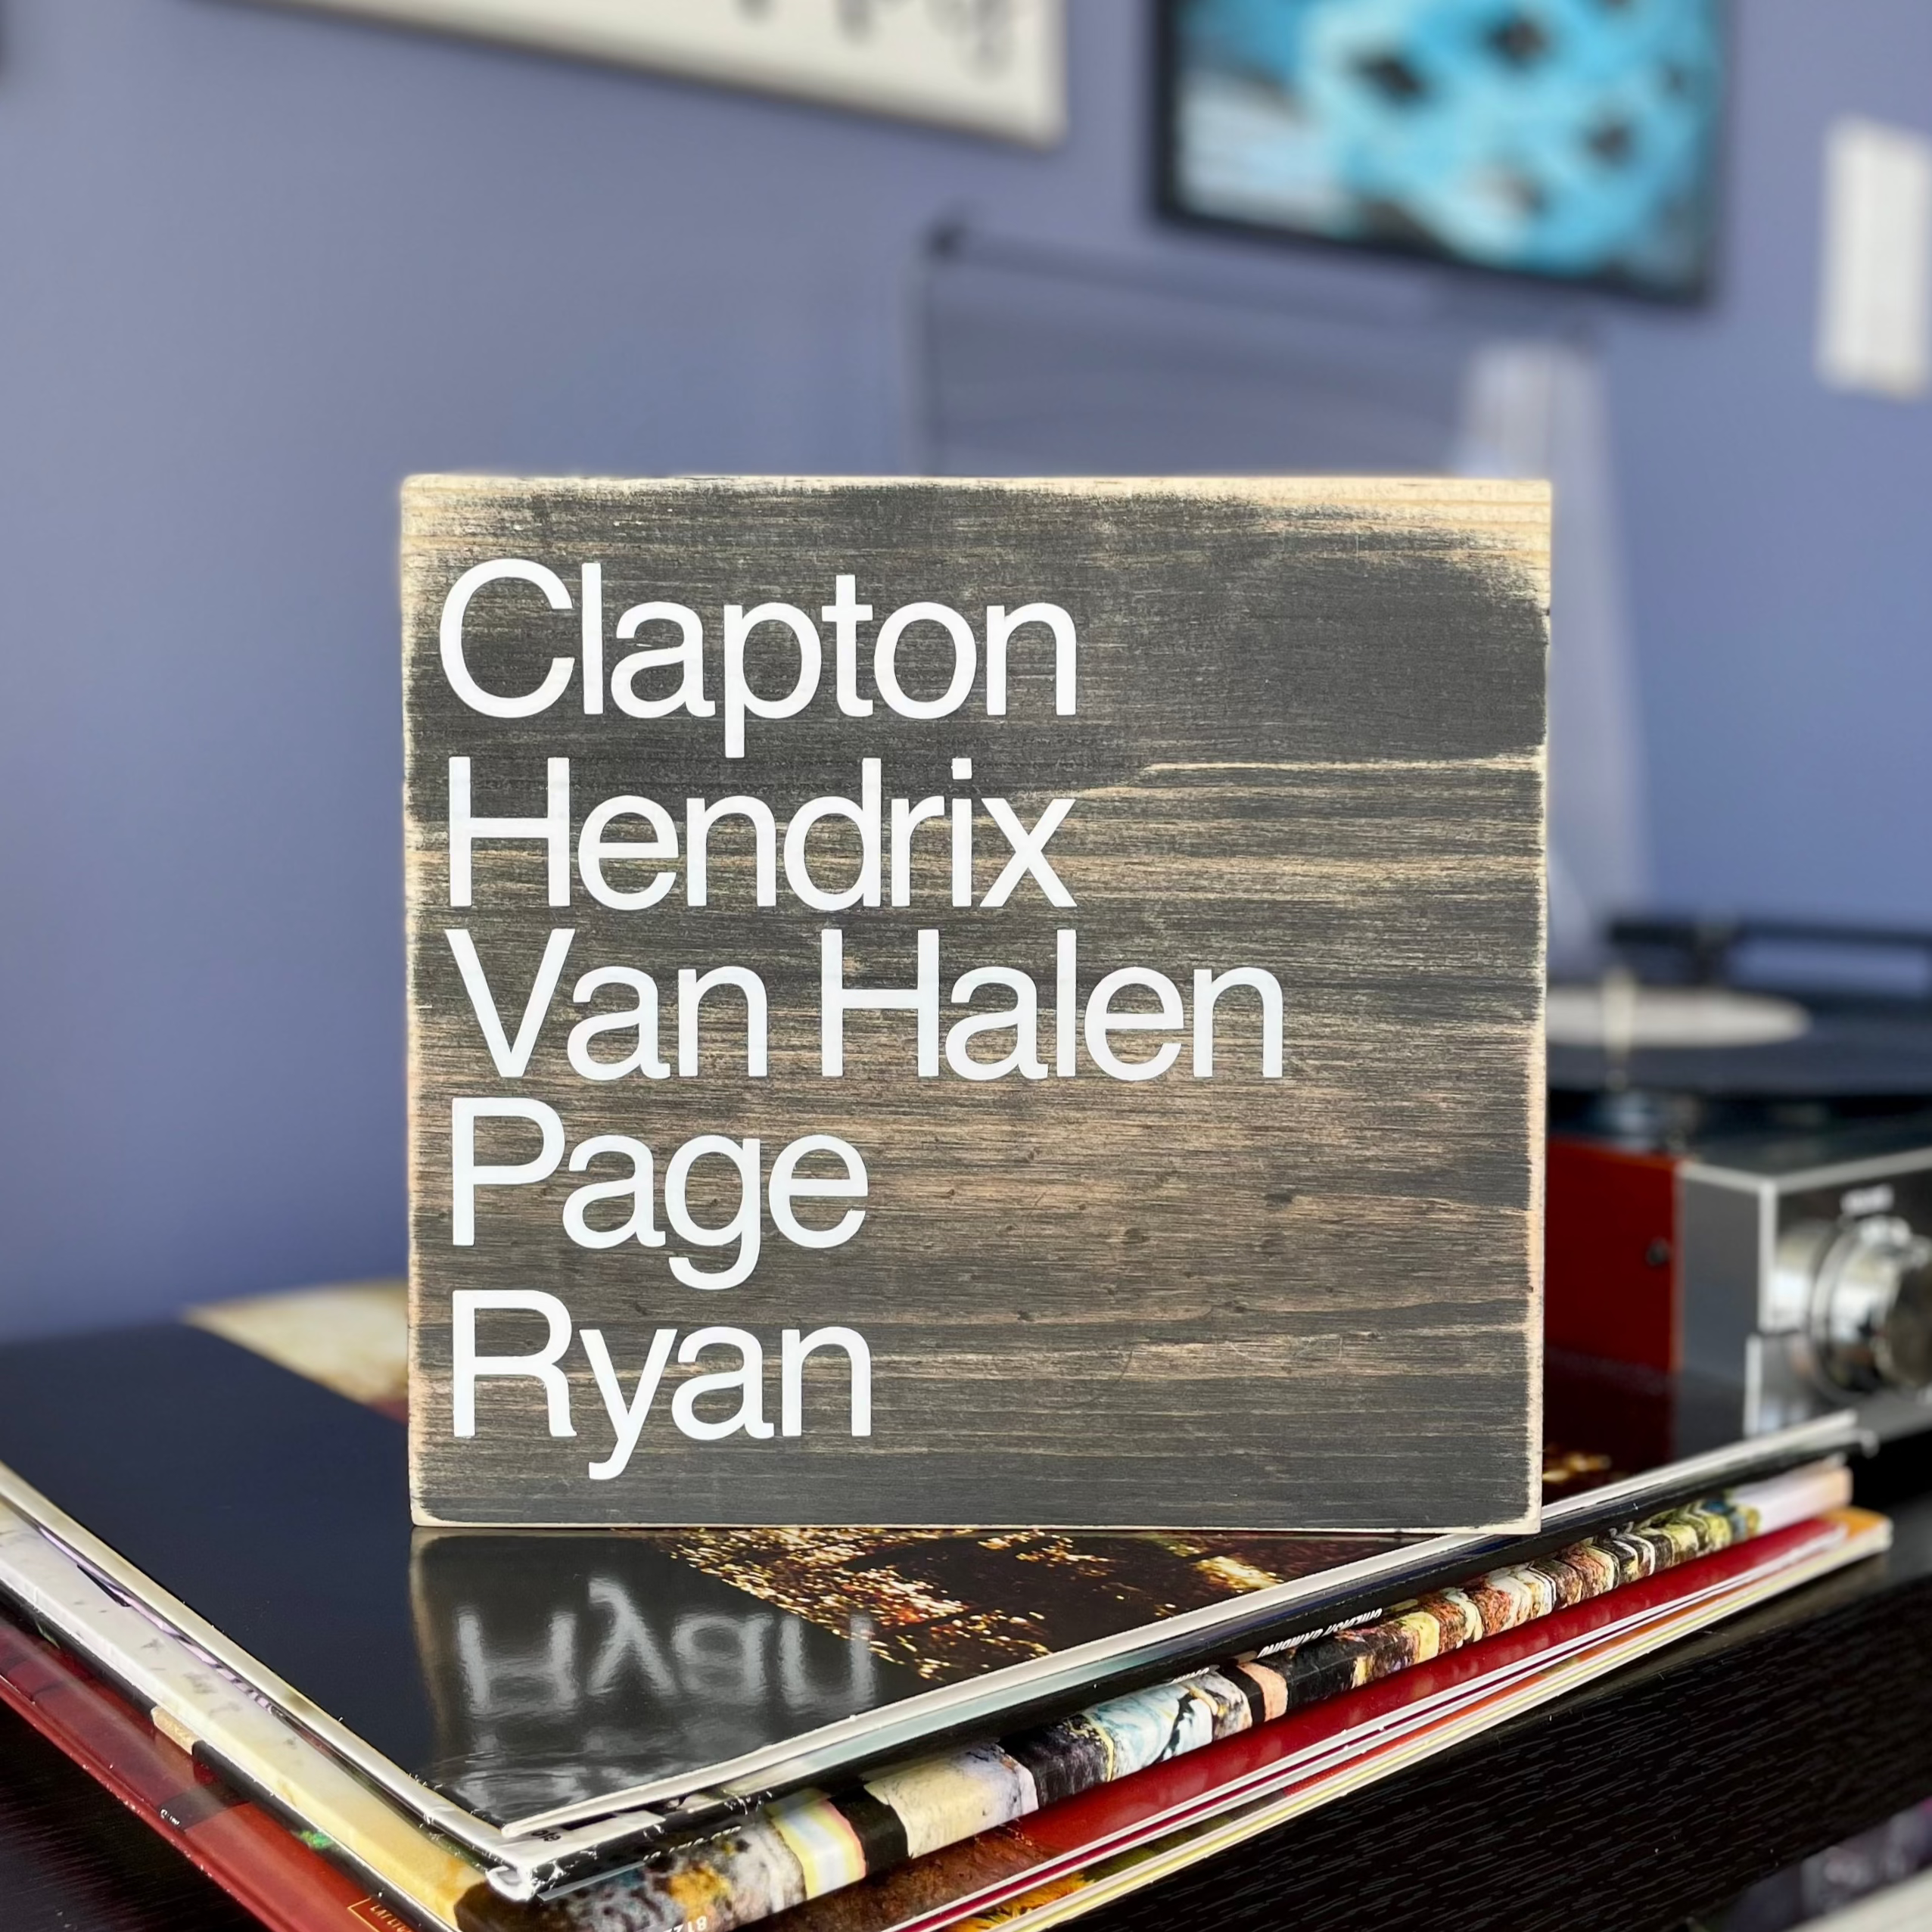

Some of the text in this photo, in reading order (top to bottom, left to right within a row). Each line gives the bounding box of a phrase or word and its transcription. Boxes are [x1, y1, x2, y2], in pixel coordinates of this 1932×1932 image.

[439, 558, 1078, 759] Clapton
[448, 756, 1078, 911] Hendrix
[443, 928, 1285, 1081] Van Halen
[452, 1097, 869, 1291] Page
[453, 1289, 872, 1481] Ryan
